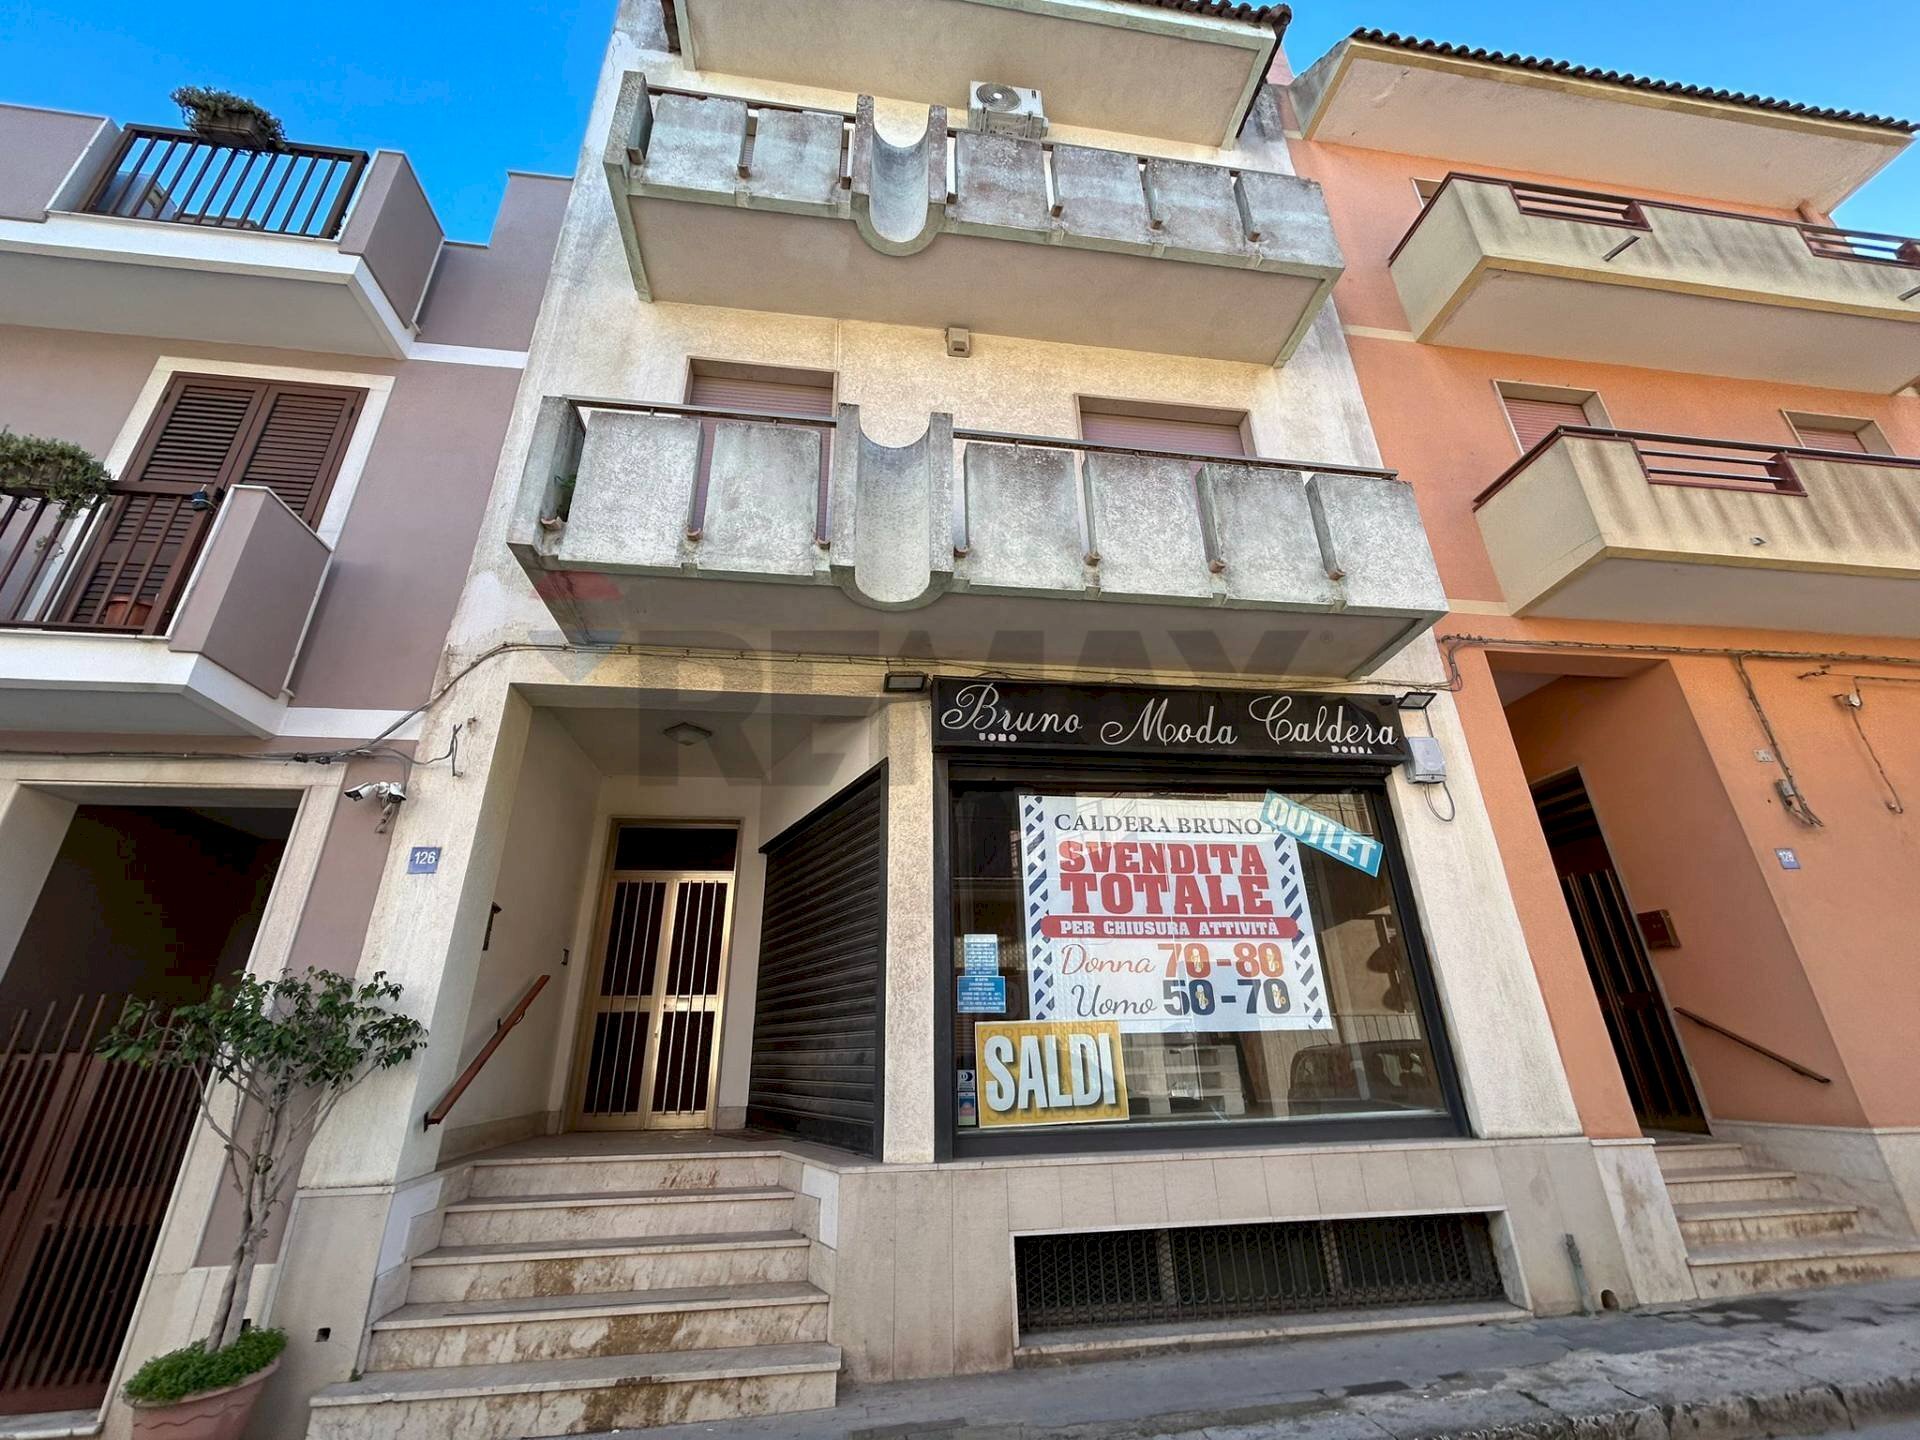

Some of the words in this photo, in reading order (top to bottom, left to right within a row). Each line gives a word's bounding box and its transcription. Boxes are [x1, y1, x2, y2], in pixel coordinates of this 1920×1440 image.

[941, 683, 1083, 733] Bruno
[1100, 698, 1238, 746] Moda
[1249, 695, 1399, 745] Caldera
[1054, 814, 1172, 833] CALDERA
[1178, 817, 1262, 835] BRUNO
[1267, 796, 1377, 868] OUTLET
[414, 850, 437, 865] 126
[1059, 840, 1267, 875] SVENDITA
[1060, 873, 1274, 915] TOTALE
[1060, 920, 1096, 935] PER
[1103, 920, 1190, 936] CHIUSURA
[1199, 918, 1280, 936] ATTIVITÀ
[1061, 943, 1157, 975] Donna
[1071, 984, 1158, 1018] Uomo
[984, 1032, 1117, 1112] SALDI
